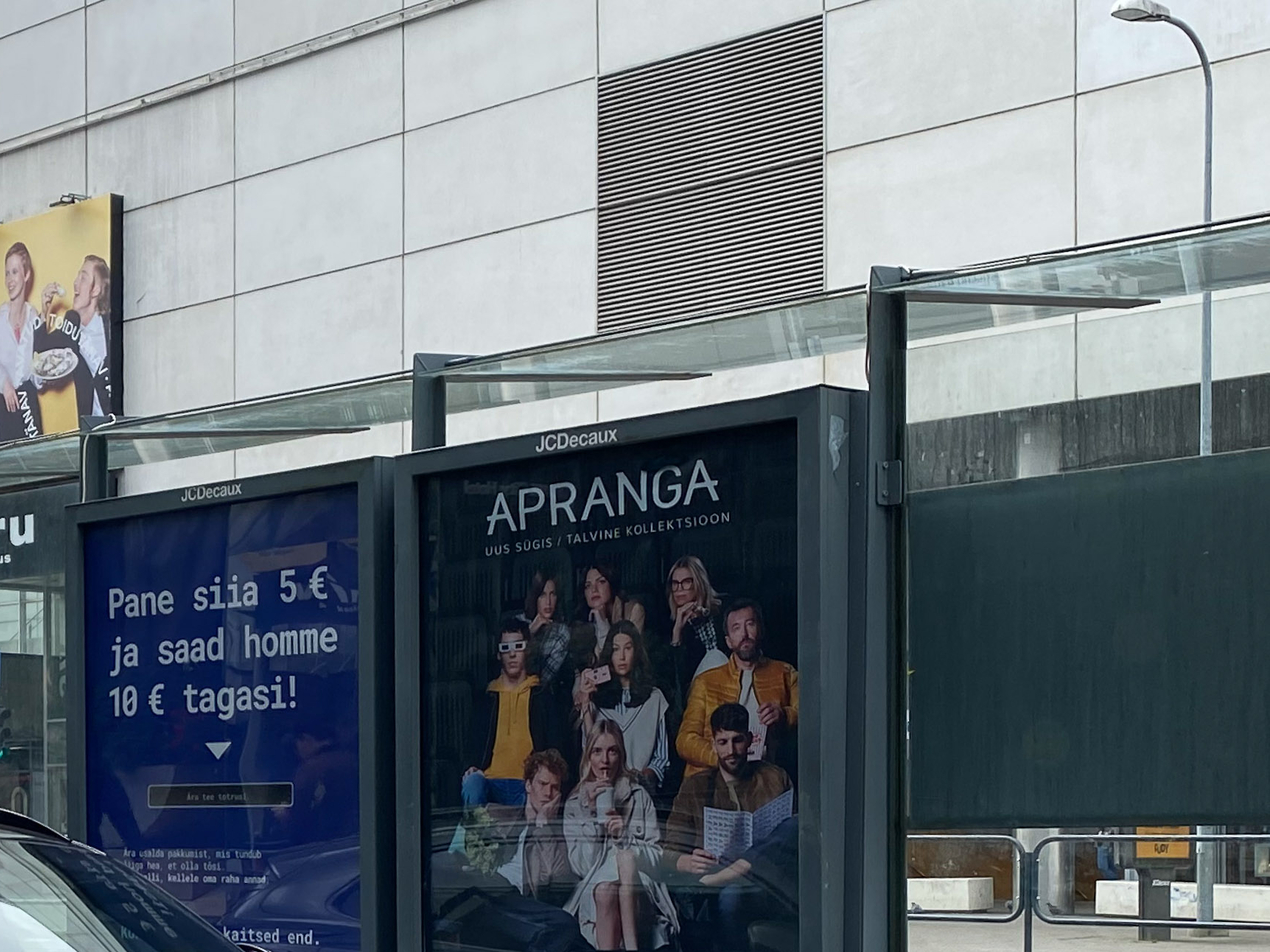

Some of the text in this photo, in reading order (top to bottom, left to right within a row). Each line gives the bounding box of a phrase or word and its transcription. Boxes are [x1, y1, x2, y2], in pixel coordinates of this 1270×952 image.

[535, 428, 618, 453] JCDecaux
[181, 483, 242, 502] JCDecaux
[486, 459, 719, 536] APRANGA
[485, 544, 510, 556] UUS
[515, 536, 553, 553] SÜGIS
[566, 527, 621, 545] TALVINE
[626, 511, 730, 536] KOLLEKTSIOON
[108, 566, 328, 619] Pane siia 5 €
[110, 636, 139, 677] ja
[158, 627, 224, 664] saad
[244, 624, 338, 658] homme
[110, 676, 297, 720] 10 € tagasi!
[139, 848, 164, 858] usalda
[216, 850, 230, 858] mis
[235, 850, 262, 859] tundub
[168, 862, 176, 870] et
[180, 861, 199, 871] olla
[168, 872, 199, 883] kellele
[202, 875, 217, 883] oma
[221, 873, 240, 884] raha
[223, 926, 320, 946] kaitsed end.
